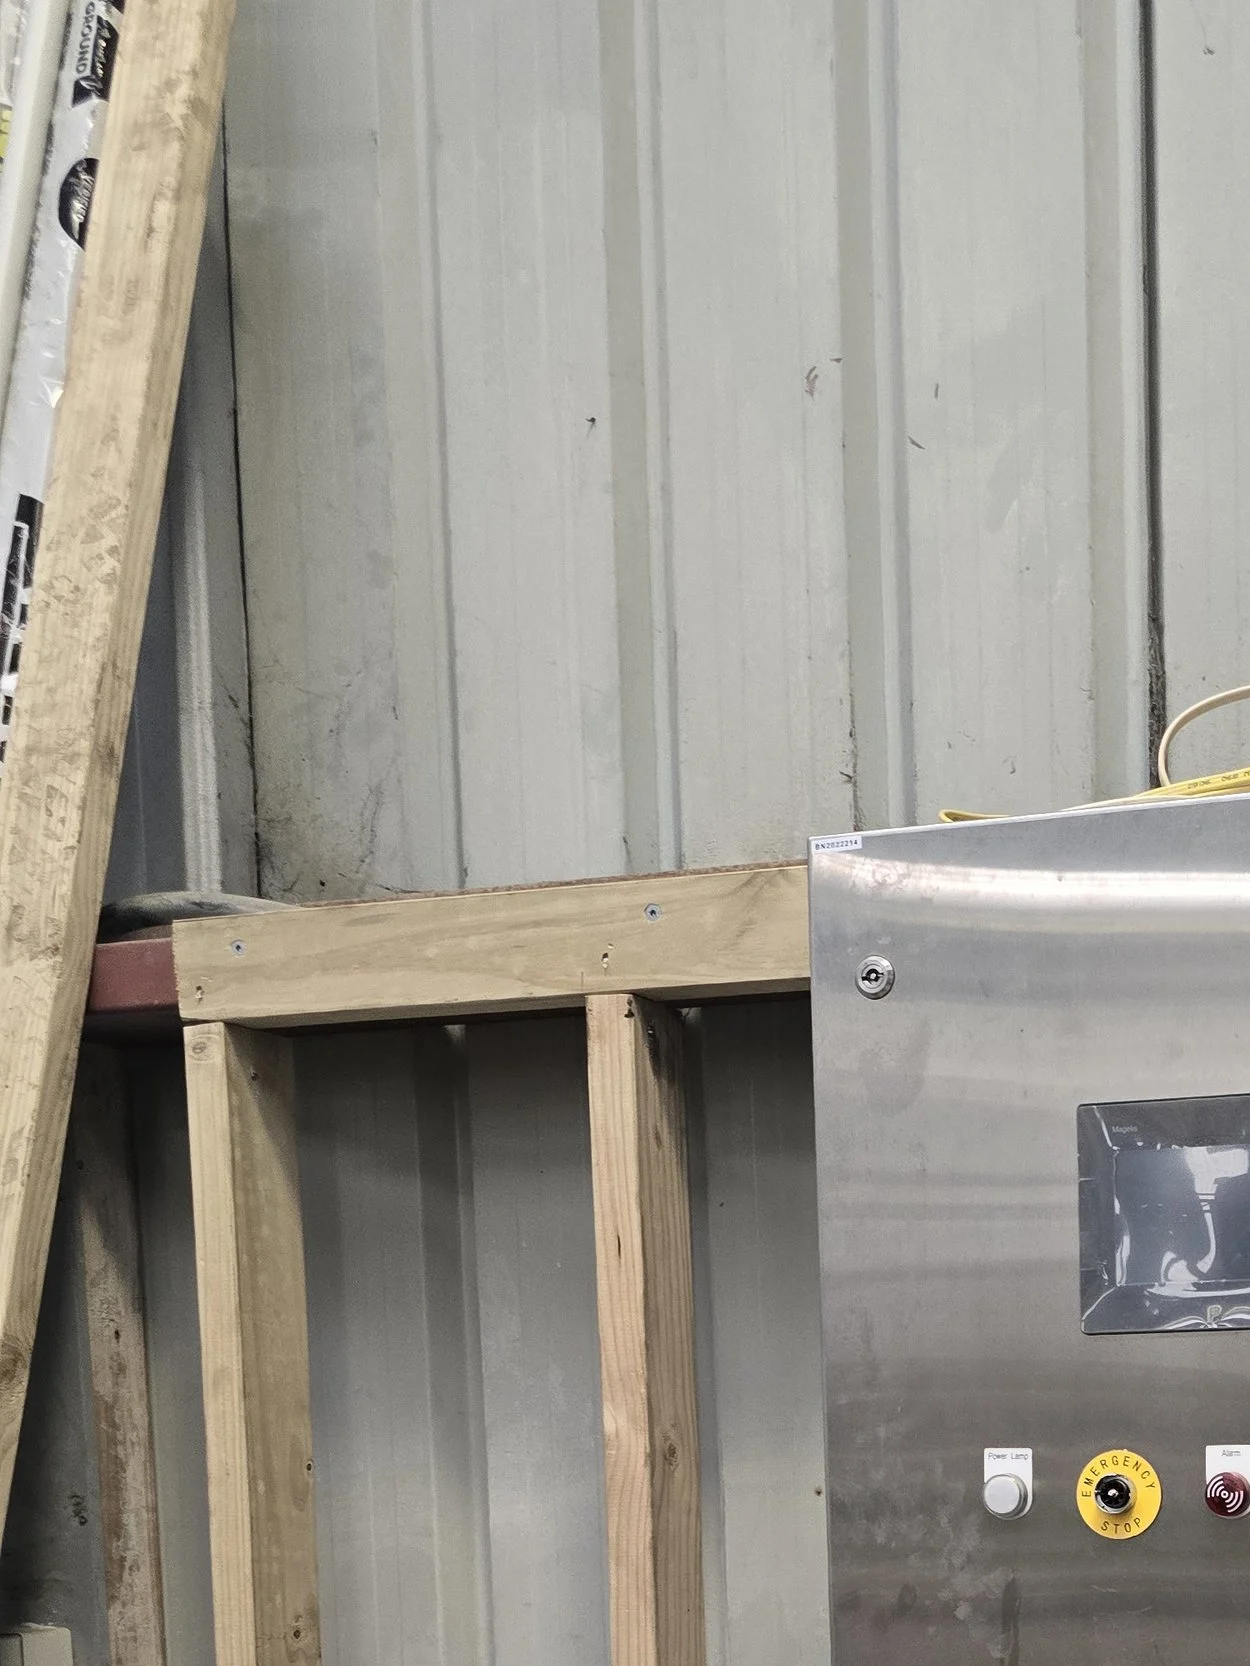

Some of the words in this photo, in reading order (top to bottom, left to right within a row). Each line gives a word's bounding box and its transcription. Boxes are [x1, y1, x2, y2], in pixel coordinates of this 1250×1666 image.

[76, 1, 95, 74] GROUND
[988, 1452, 1008, 1460] Power
[1011, 1452, 1029, 1460] Lamp
[1221, 1449, 1241, 1457] Alarm
[1082, 1454, 1156, 1498] EMERGENCY
[1100, 1516, 1142, 1535] STOP
